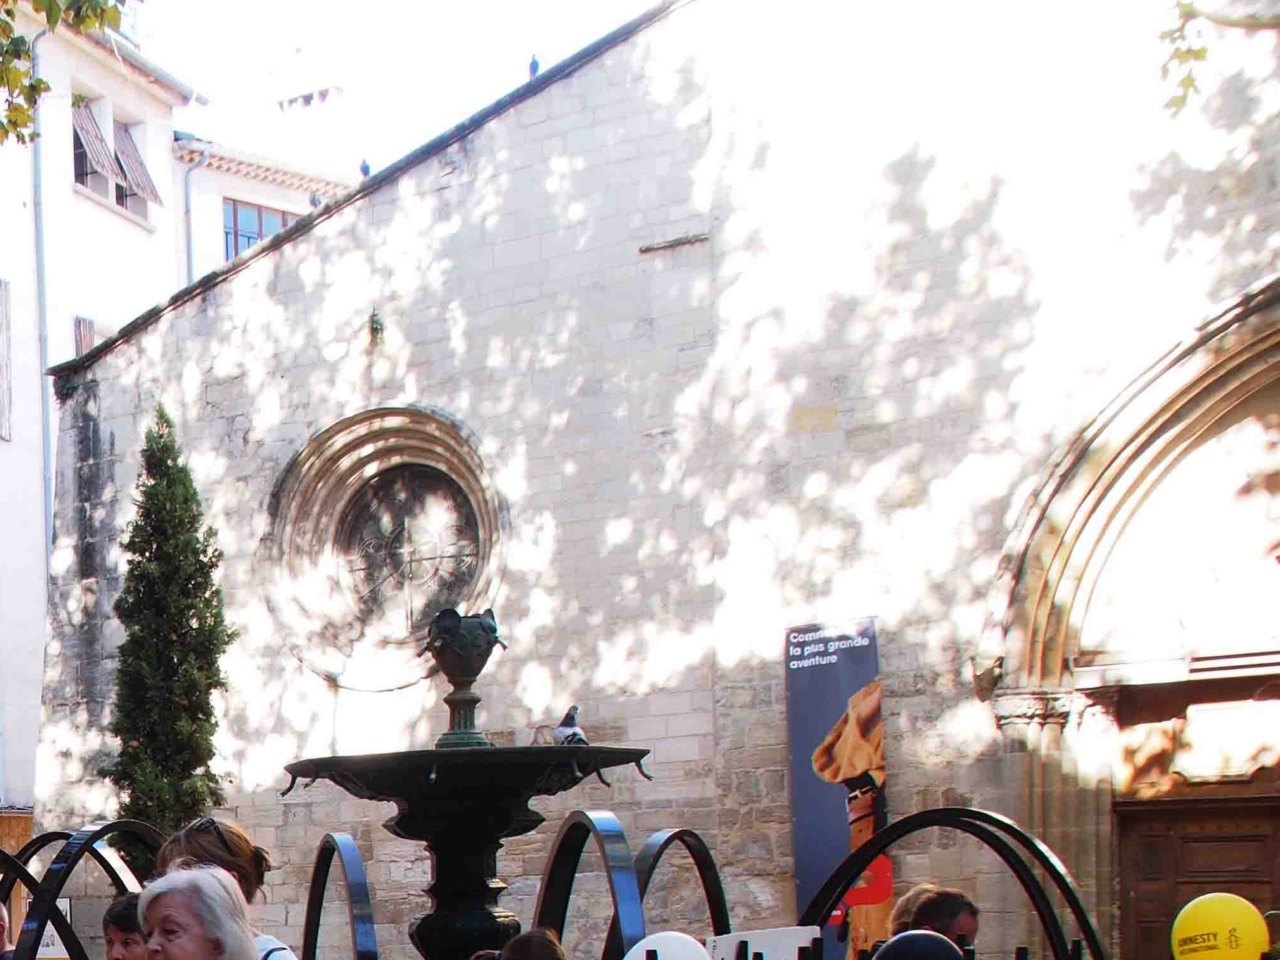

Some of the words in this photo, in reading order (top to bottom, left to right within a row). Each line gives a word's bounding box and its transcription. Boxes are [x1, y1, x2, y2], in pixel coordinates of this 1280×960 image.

[790, 646, 802, 656] la
[804, 642, 825, 657] plus
[828, 636, 870, 652] grande
[790, 654, 838, 669] aventure
[1178, 931, 1218, 947] AMNESTY
